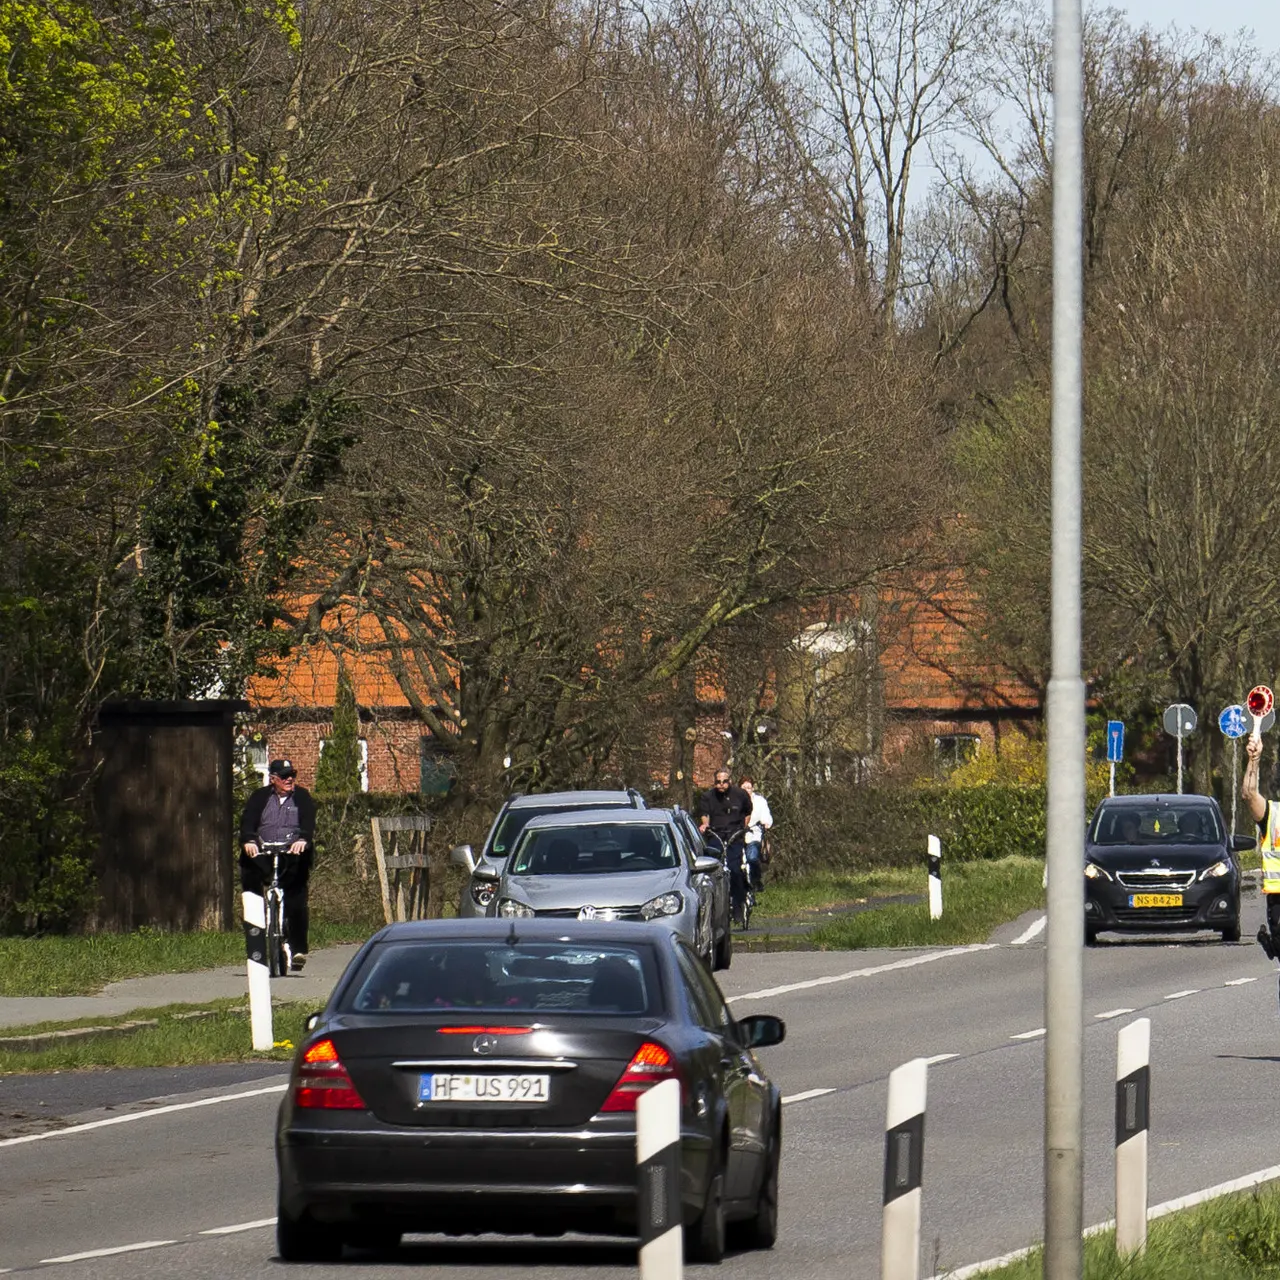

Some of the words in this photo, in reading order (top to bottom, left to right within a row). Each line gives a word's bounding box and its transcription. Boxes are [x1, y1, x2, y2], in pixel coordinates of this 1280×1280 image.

[434, 1077, 461, 1098] HF
[475, 1077, 502, 1098] US
[507, 1077, 545, 1098] 991
